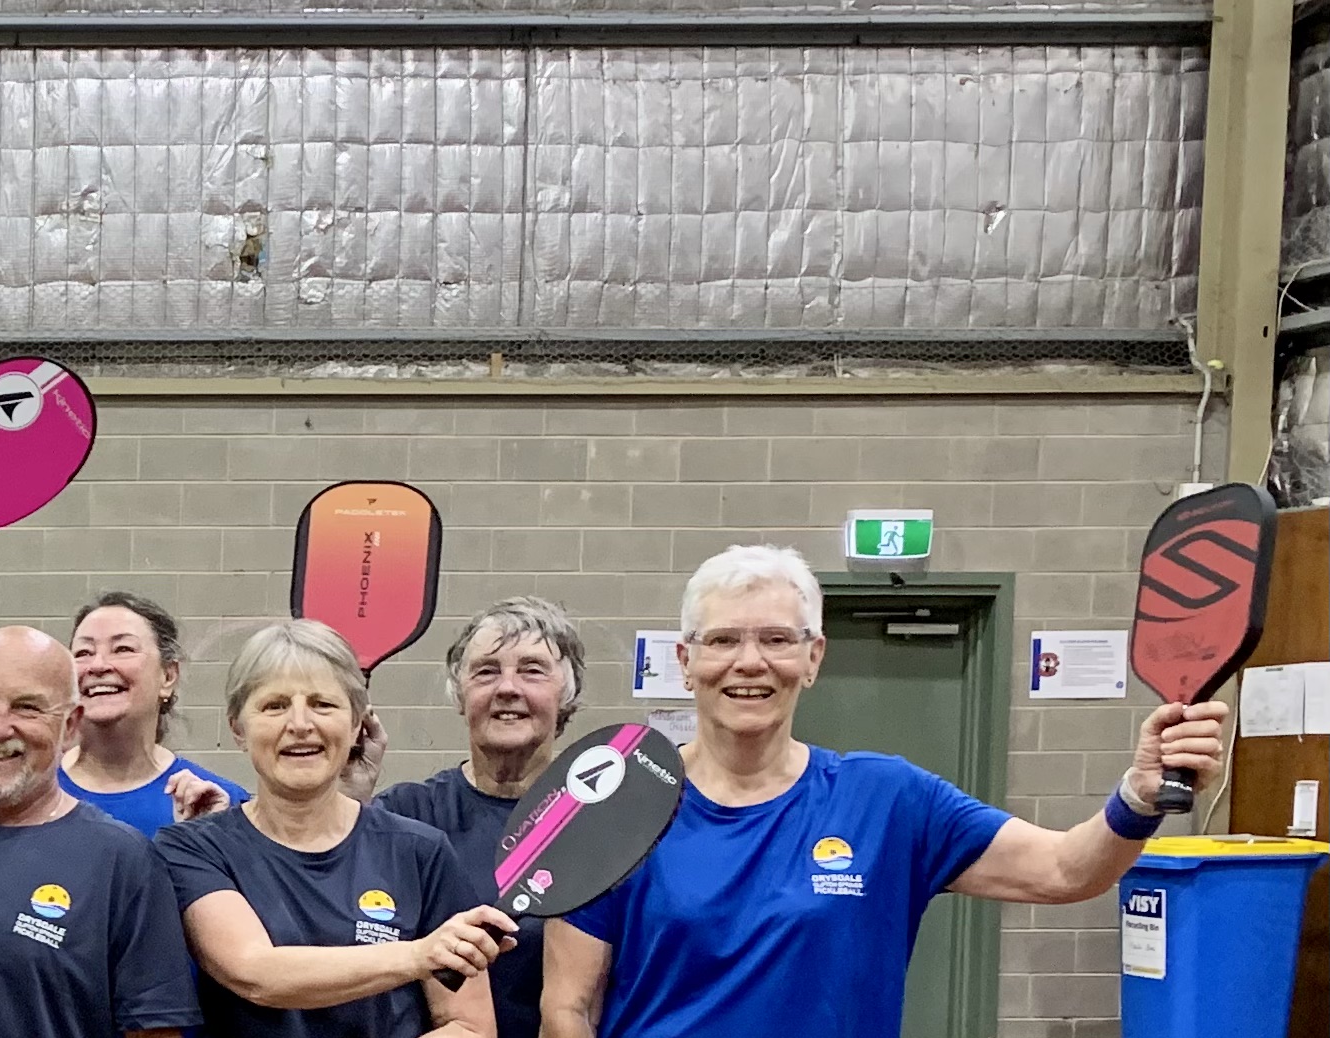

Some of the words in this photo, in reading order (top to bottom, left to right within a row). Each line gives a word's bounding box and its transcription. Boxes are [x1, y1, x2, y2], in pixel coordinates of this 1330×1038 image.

[334, 508, 407, 516] PADDLETEK
[357, 531, 373, 618] PHOENIX
[811, 874, 862, 882] DRYSDALE
[1129, 894, 1160, 914] VISY
[17, 913, 66, 936] DRYSDALE
